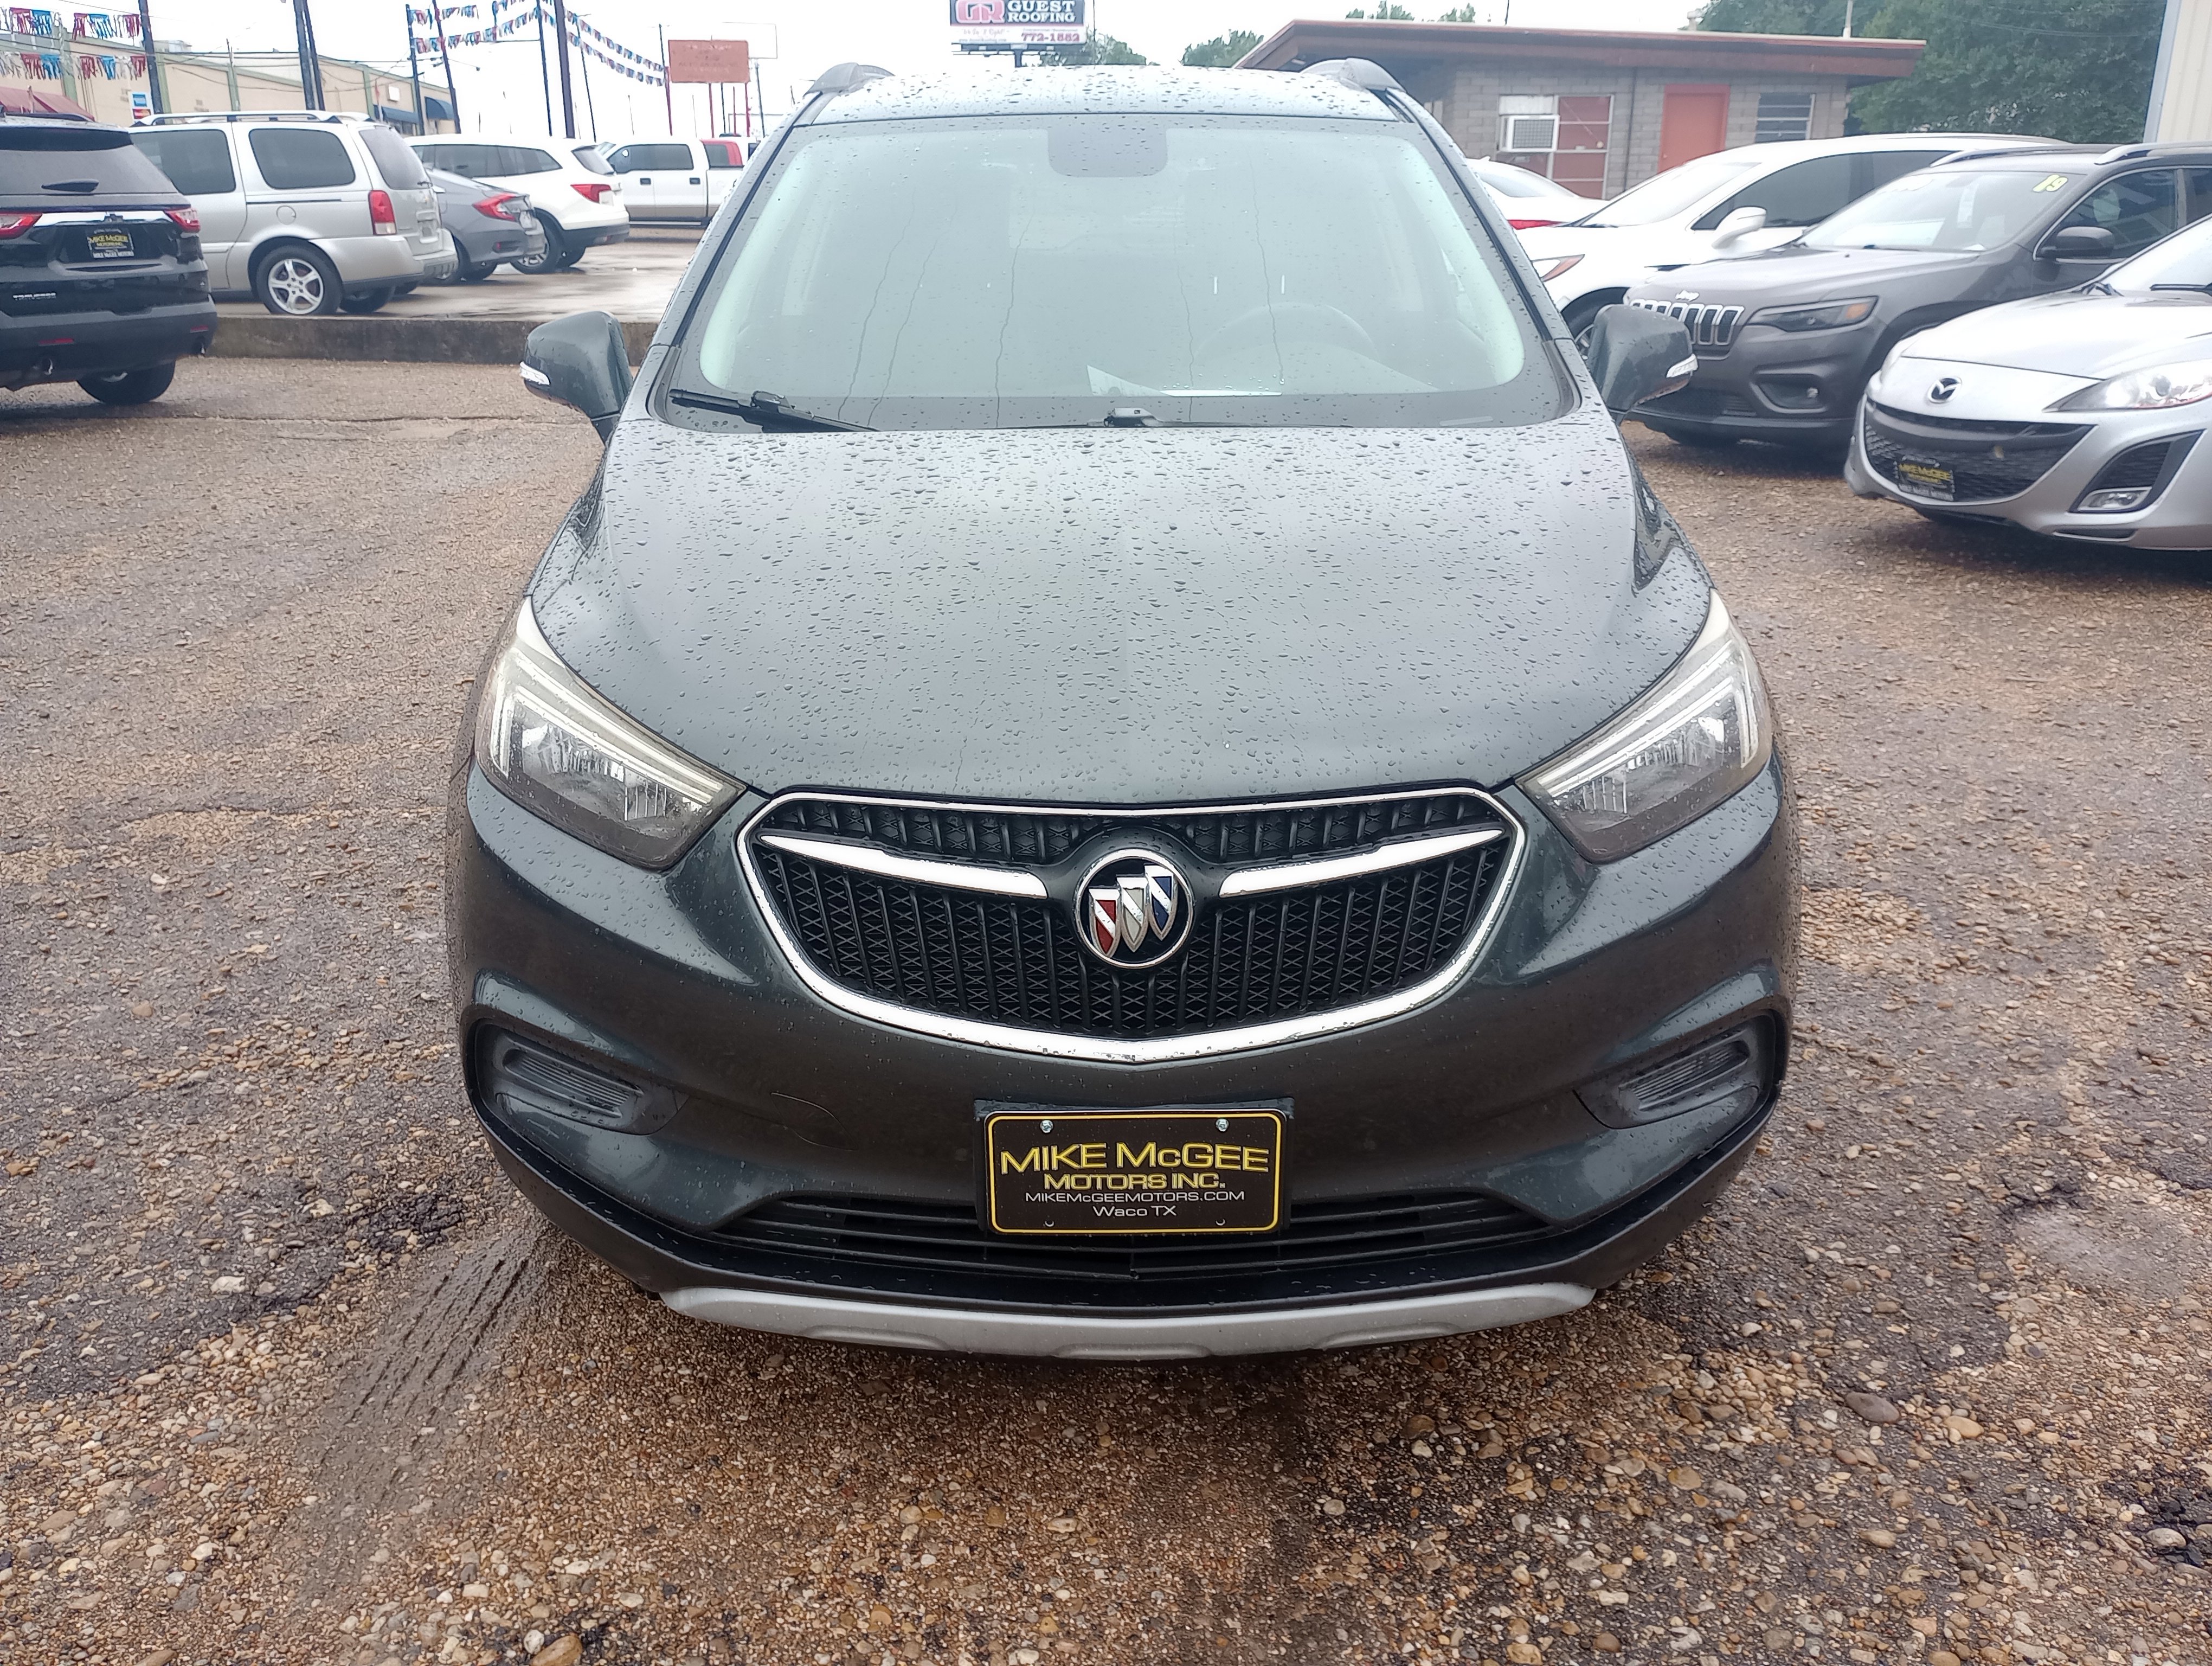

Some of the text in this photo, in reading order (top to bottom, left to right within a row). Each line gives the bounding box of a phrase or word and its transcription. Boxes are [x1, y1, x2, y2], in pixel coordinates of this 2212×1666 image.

[1007, 0, 1076, 12] GUEST
[1007, 12, 1076, 22] ROOFING
[2033, 174, 2068, 192] 19
[1001, 1142, 1269, 1175] MIKE McGEE
[1044, 1172, 1226, 1190] MOTORS INC.
[1025, 1191, 1245, 1203] MIKEMcGEEMOTORS.COM
[1092, 1205, 1177, 1218] Waco TX
